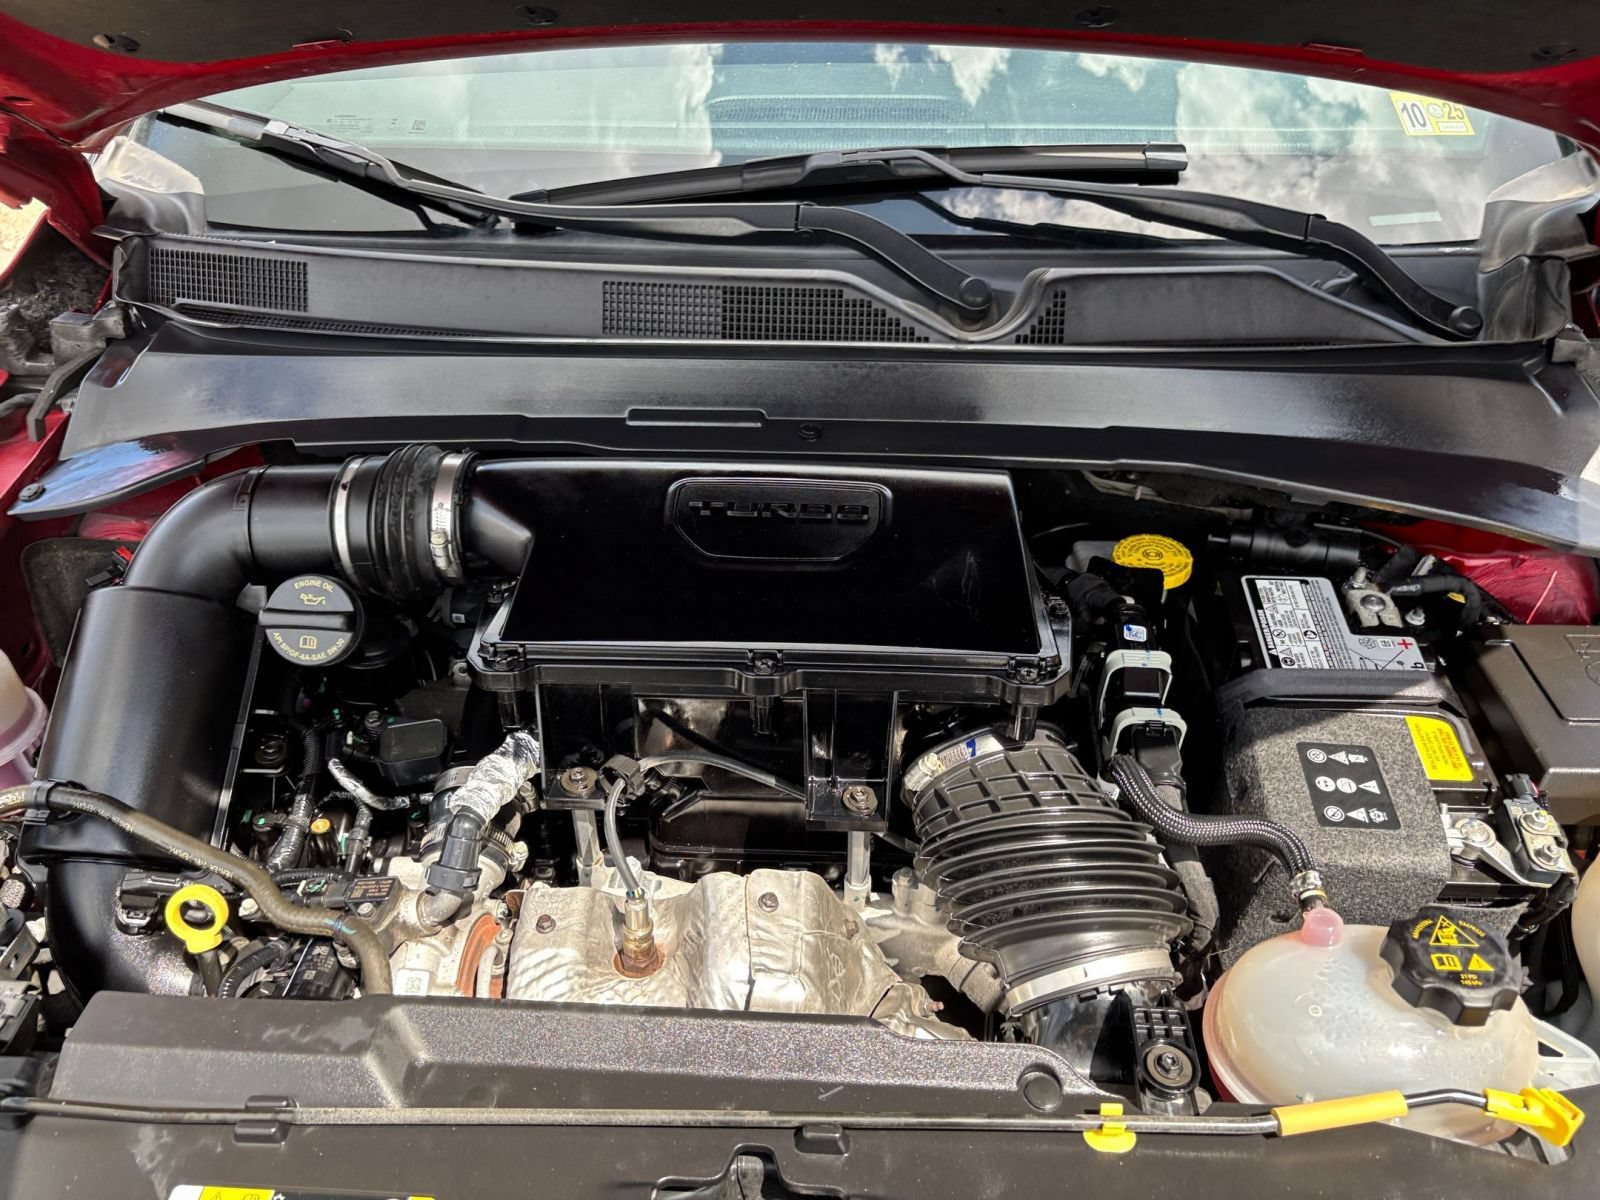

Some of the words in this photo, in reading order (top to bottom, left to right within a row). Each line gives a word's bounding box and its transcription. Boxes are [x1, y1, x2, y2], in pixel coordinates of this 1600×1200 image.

[1401, 103, 1426, 128] 10
[1443, 102, 1464, 120] 25
[689, 501, 869, 520] TURBO
[294, 579, 321, 590] ENGINE
[322, 580, 334, 592] OIL
[273, 632, 283, 645] API
[327, 638, 345, 656] 5W-30
